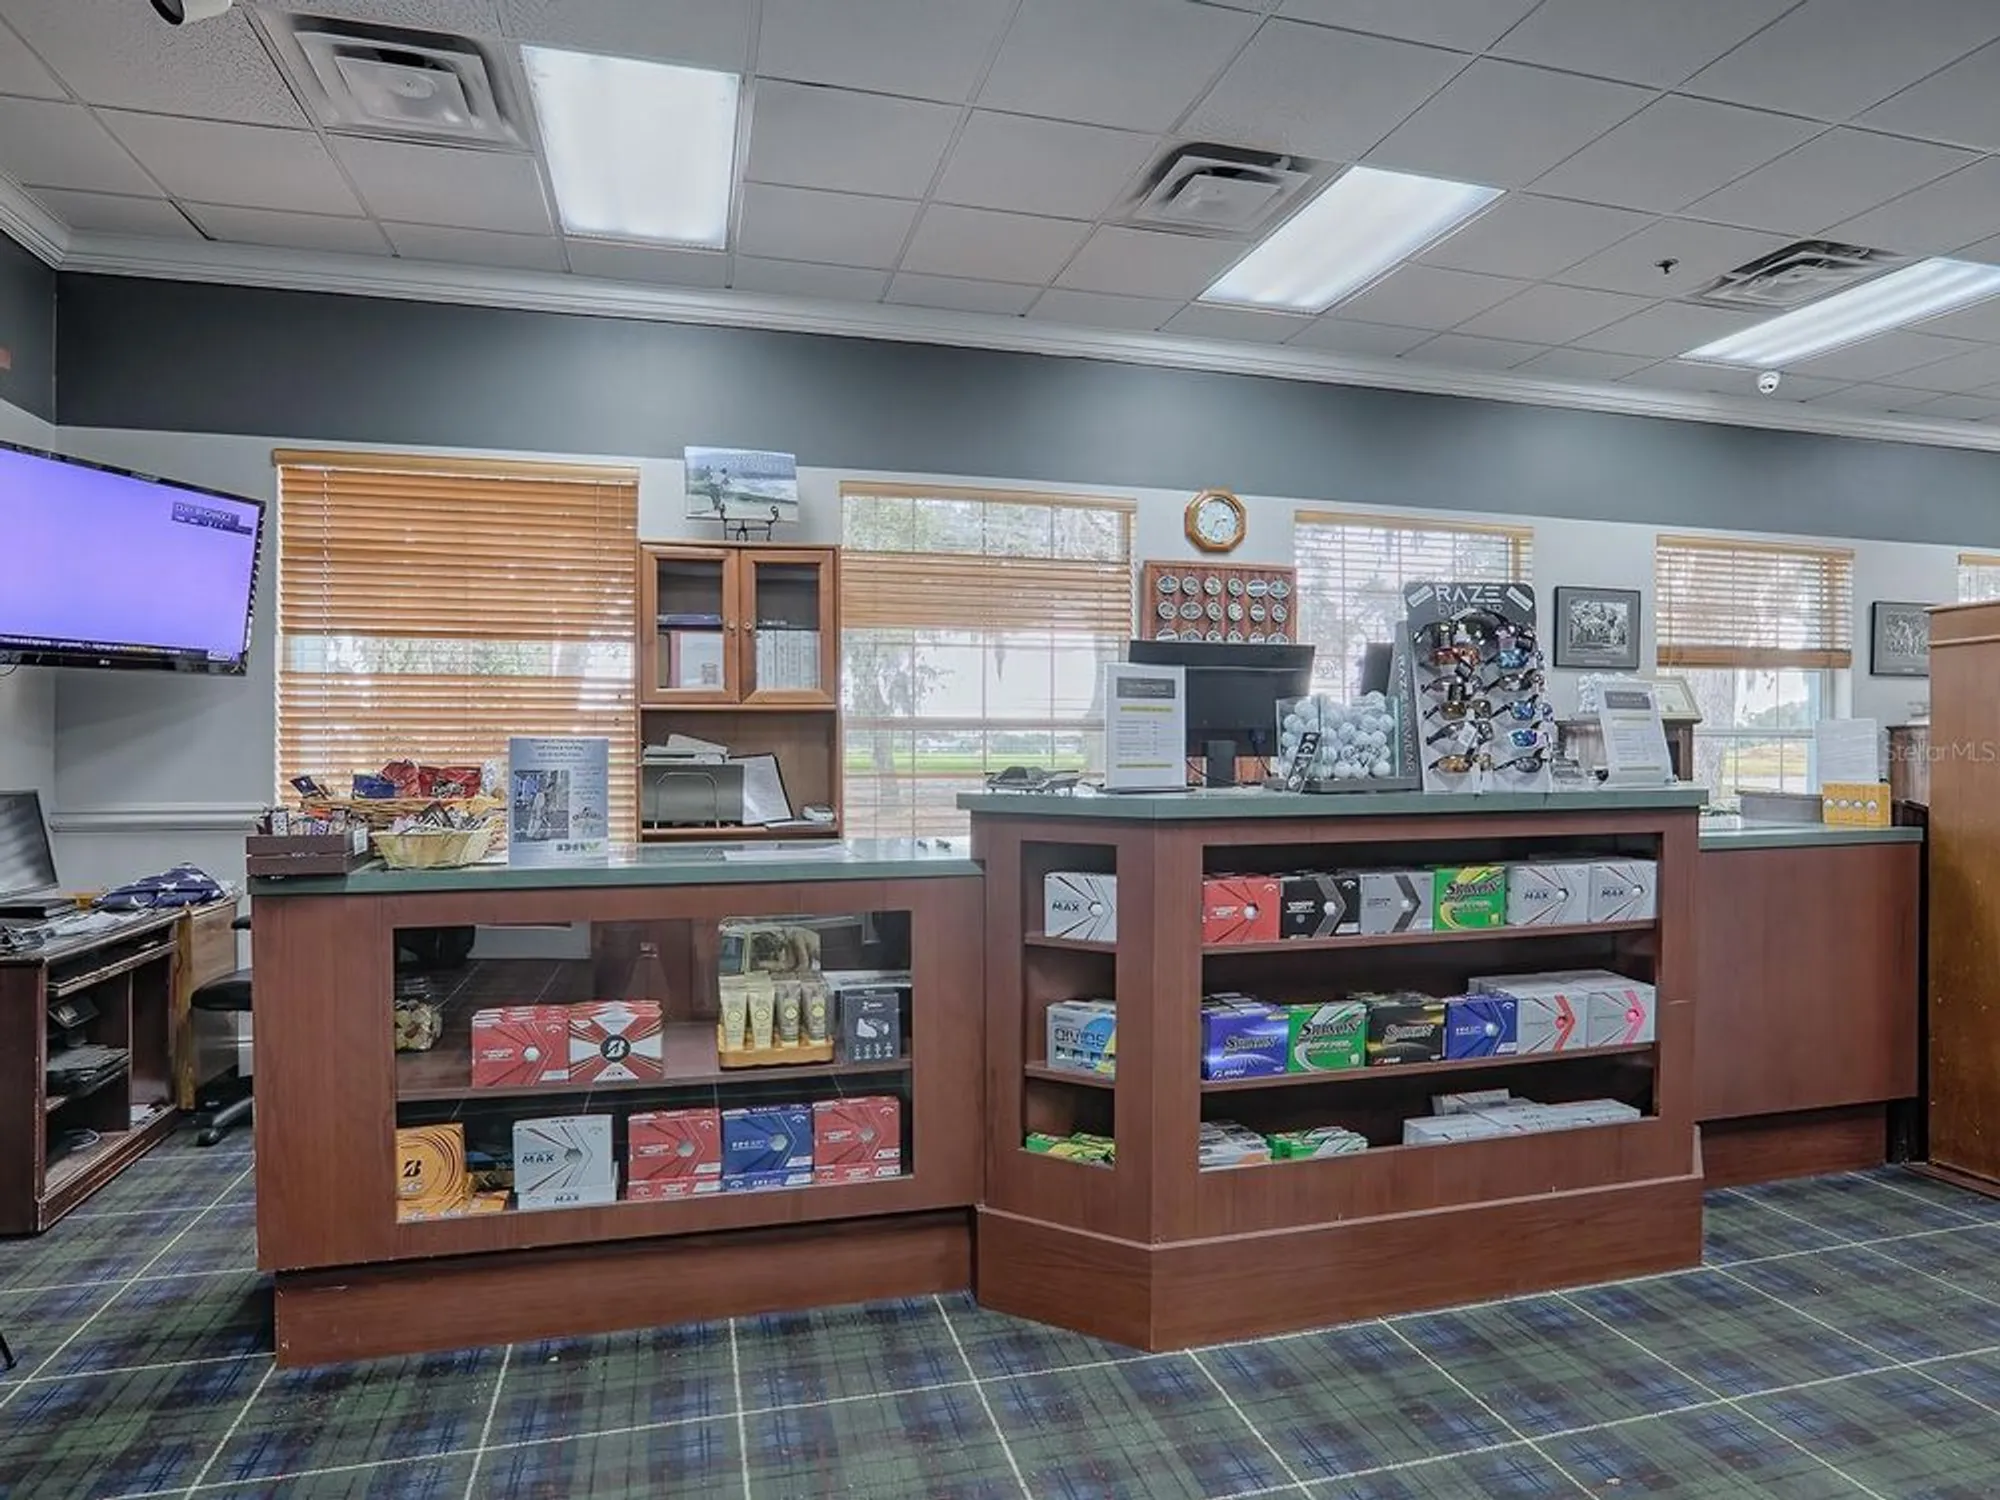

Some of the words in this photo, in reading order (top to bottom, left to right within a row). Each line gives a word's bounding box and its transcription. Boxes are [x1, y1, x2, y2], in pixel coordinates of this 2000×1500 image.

[1434, 585, 1503, 603] RAZE
[1524, 891, 1550, 901] MAX
[1602, 888, 1625, 898] MAX
[1051, 902, 1080, 912] MAX
[522, 1153, 555, 1164] MAX
[553, 1194, 580, 1204] MAX
